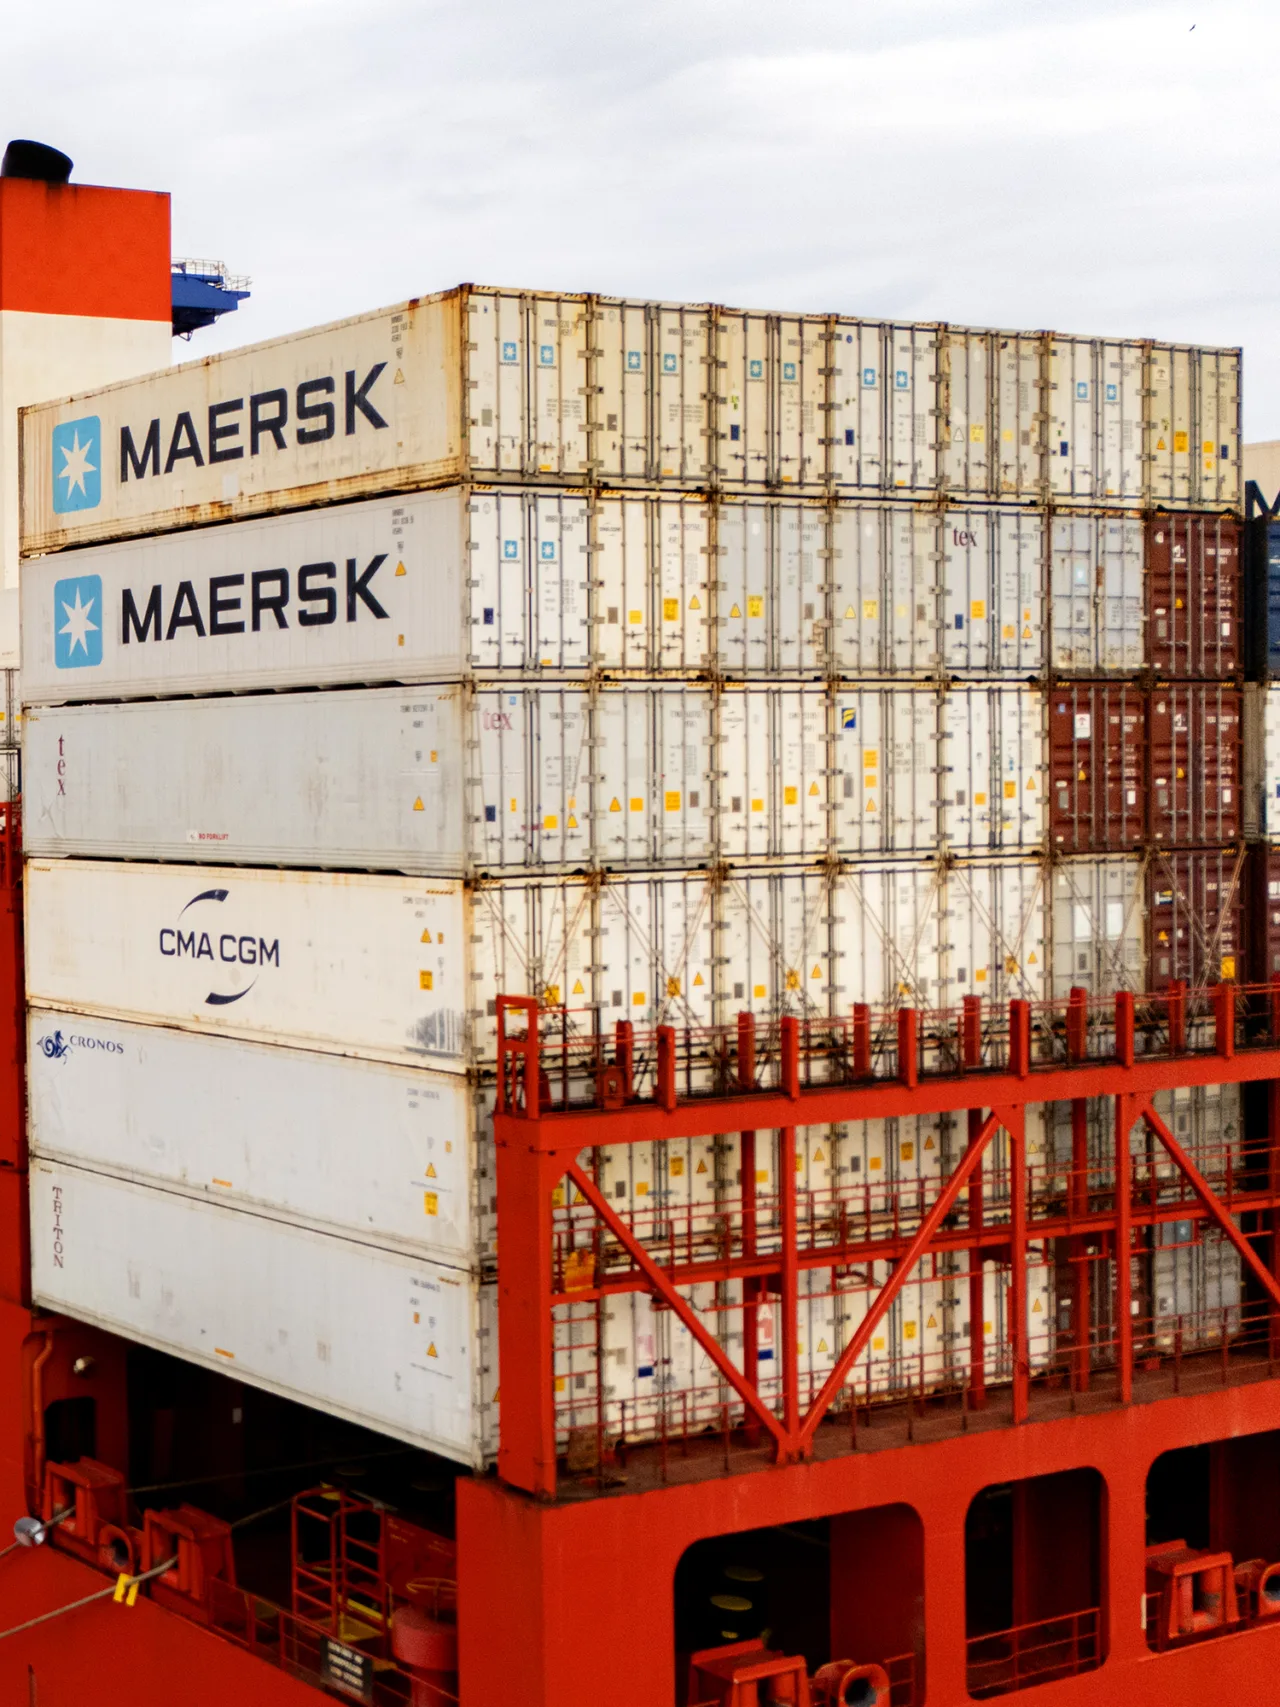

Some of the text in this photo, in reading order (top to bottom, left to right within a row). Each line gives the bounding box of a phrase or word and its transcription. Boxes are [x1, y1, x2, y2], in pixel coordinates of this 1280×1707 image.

[120, 361, 390, 483] MAERSK
[952, 526, 978, 548] tex
[122, 553, 391, 645] MAERSK
[483, 708, 513, 731] tex
[57, 734, 67, 796] tex
[160, 928, 280, 968] CMA CGM
[70, 1034, 125, 1055] CRONOS
[52, 1186, 64, 1269] TRITON
